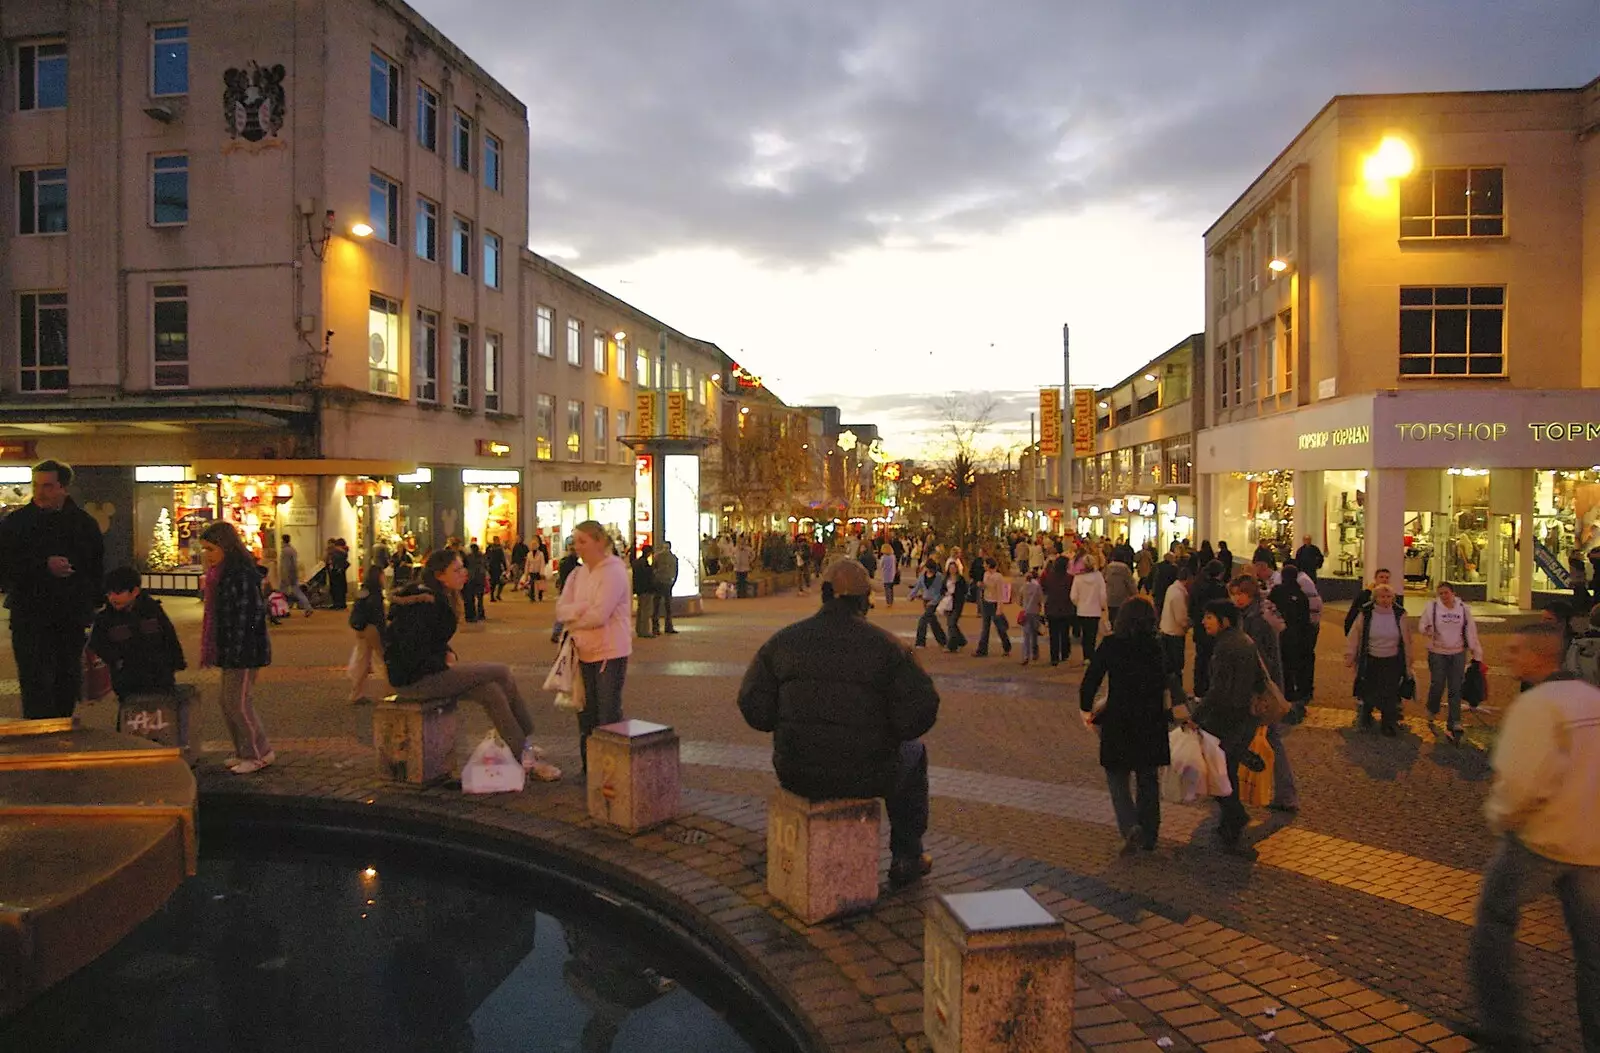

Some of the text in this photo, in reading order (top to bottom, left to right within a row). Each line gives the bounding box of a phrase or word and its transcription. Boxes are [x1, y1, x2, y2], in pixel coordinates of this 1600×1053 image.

[637, 395, 649, 439] erald
[669, 395, 681, 439] erald
[1040, 392, 1053, 452] Herald
[1075, 391, 1088, 452] Herald
[1395, 421, 1509, 443] TOPSHOP
[178, 521, 191, 539] 3
